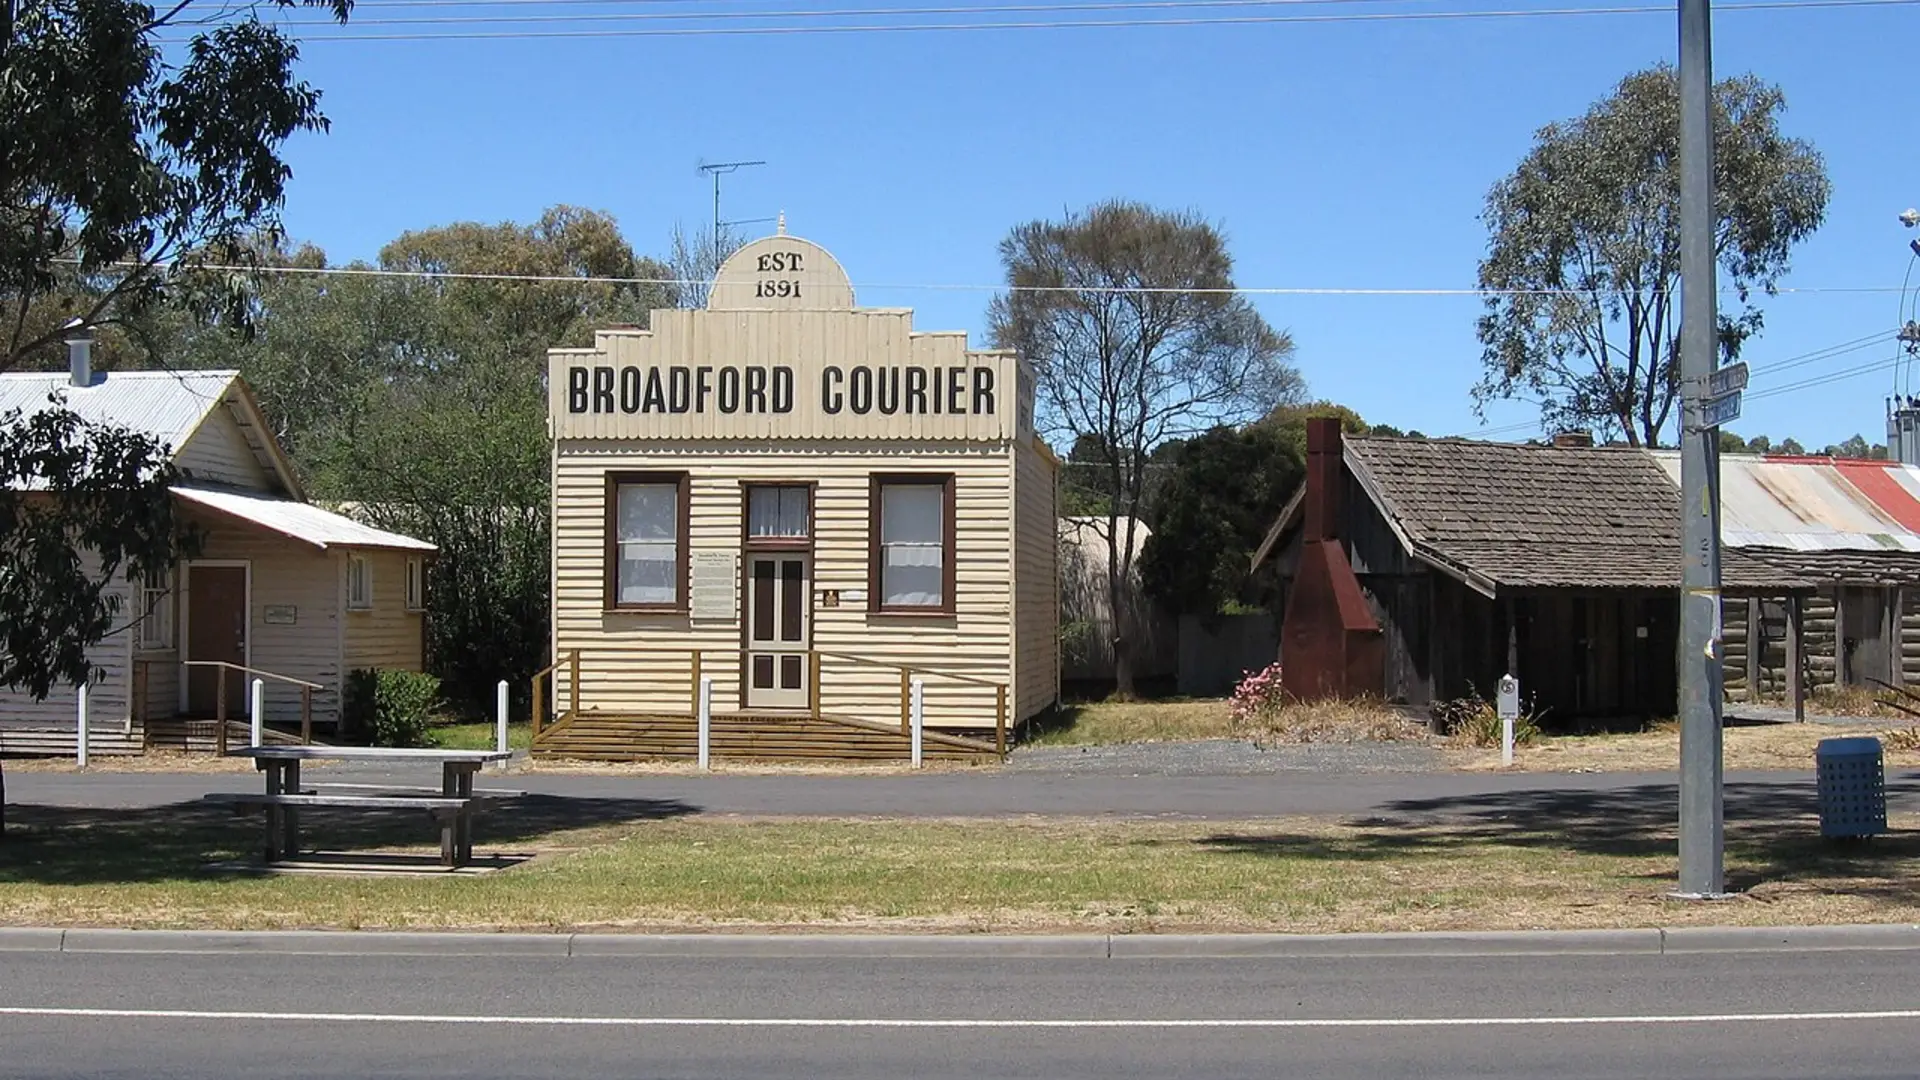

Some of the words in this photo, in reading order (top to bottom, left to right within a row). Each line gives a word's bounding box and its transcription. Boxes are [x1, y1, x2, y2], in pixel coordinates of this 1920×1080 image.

[756, 252, 804, 272] EST.
[756, 280, 802, 298] 1891
[568, 365, 794, 414] BROADFORD
[821, 365, 996, 414] COURIER
